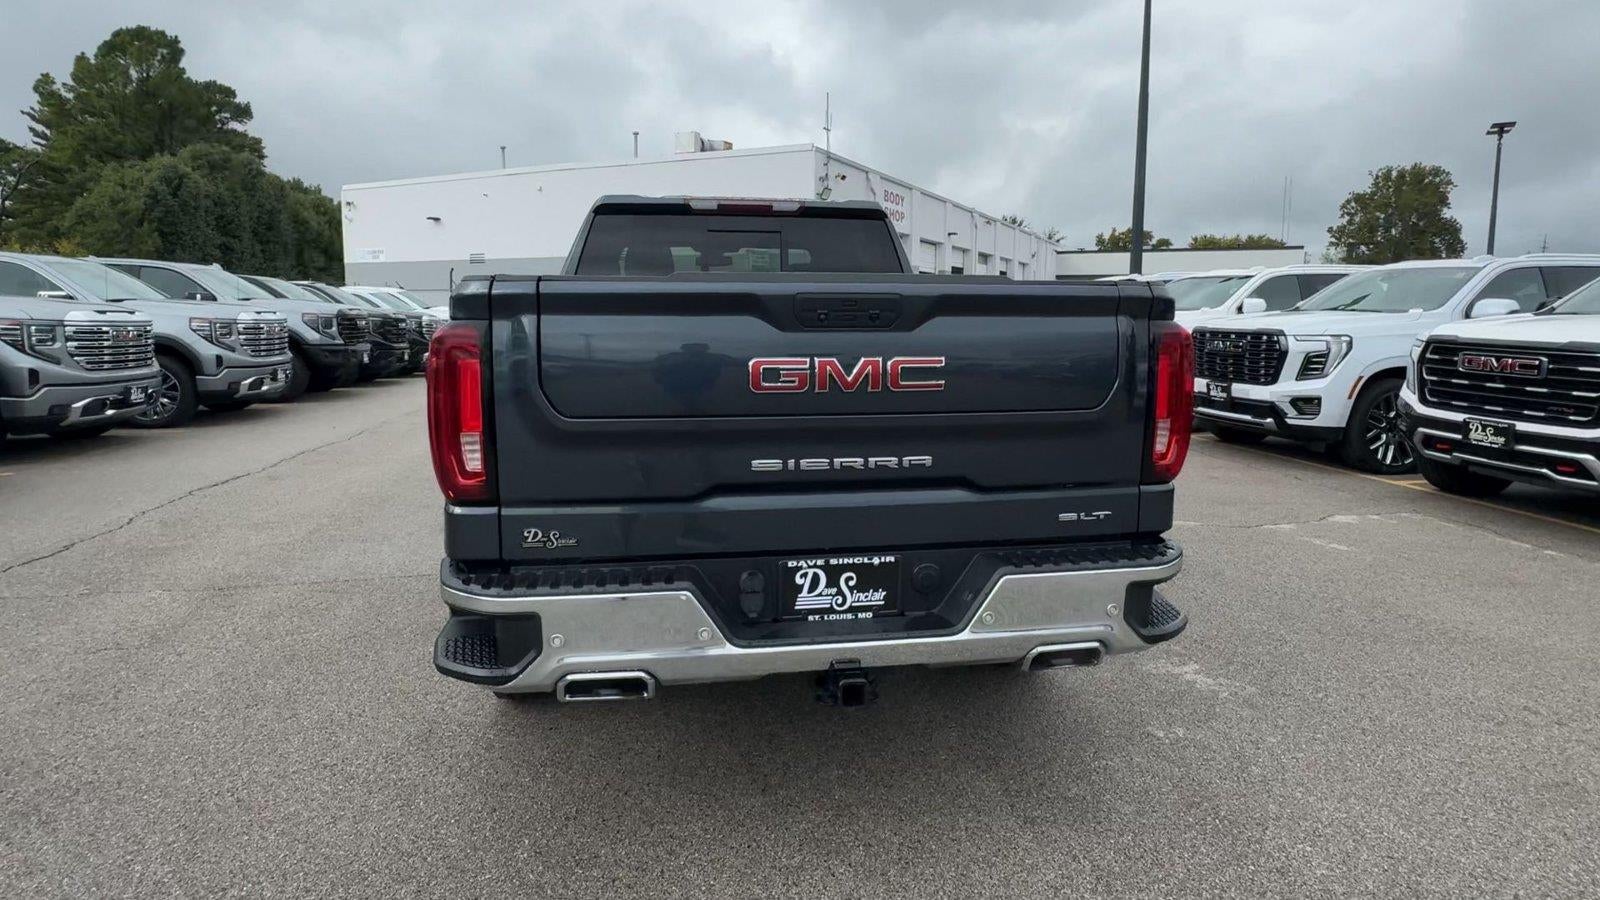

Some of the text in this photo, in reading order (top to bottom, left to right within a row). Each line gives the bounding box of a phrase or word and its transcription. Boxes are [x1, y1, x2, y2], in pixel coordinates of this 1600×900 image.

[884, 189, 905, 206] BODY
[1463, 354, 1540, 376] GMC
[748, 356, 946, 393] GMC
[751, 456, 933, 471] SIERRA
[1058, 511, 1112, 521] SLT
[787, 556, 896, 568] DAVE SINCLAIR
[795, 568, 887, 611] Dave Sinclair
